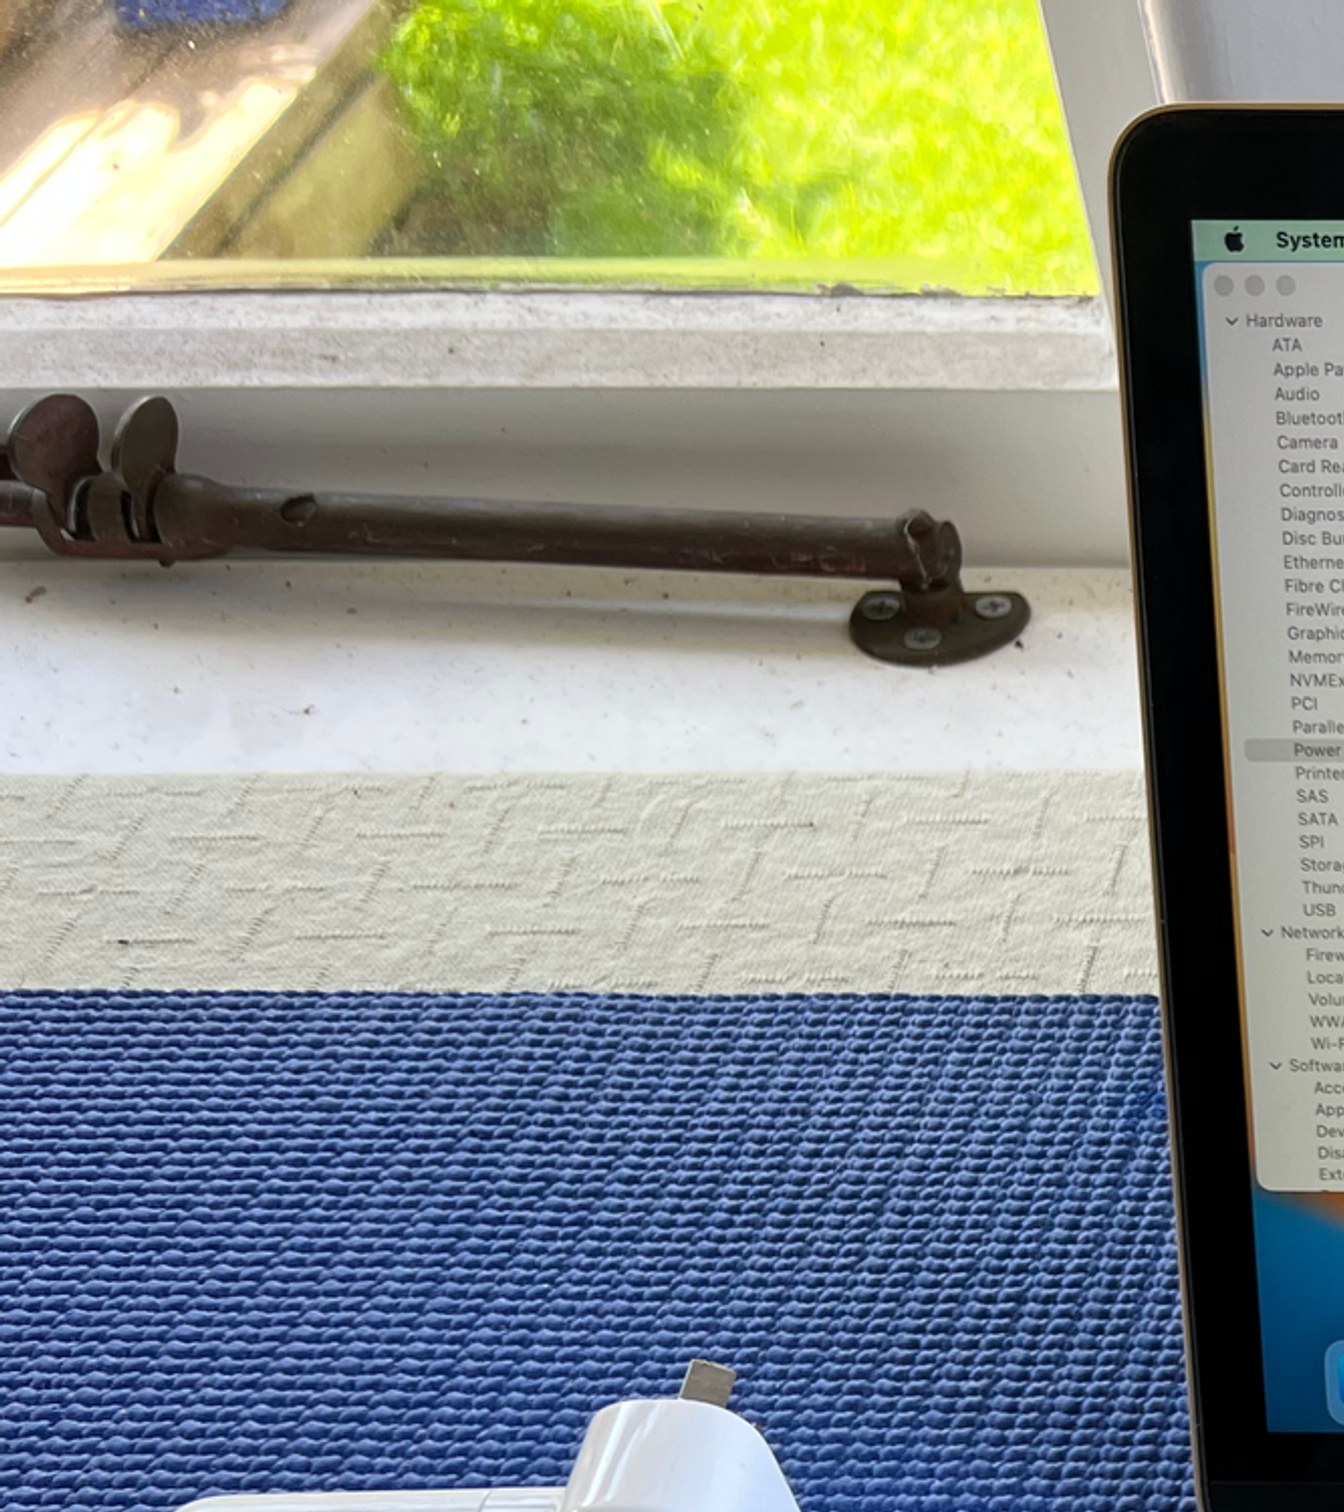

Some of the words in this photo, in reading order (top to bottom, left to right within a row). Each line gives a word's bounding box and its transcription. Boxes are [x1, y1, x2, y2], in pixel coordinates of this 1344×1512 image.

[1245, 313, 1323, 328] Hardware
[1271, 336, 1303, 352] ATA
[1272, 361, 1320, 379] Apple
[1276, 434, 1339, 451] Camera
[1277, 458, 1316, 475] Card
[1293, 741, 1342, 758] Power
